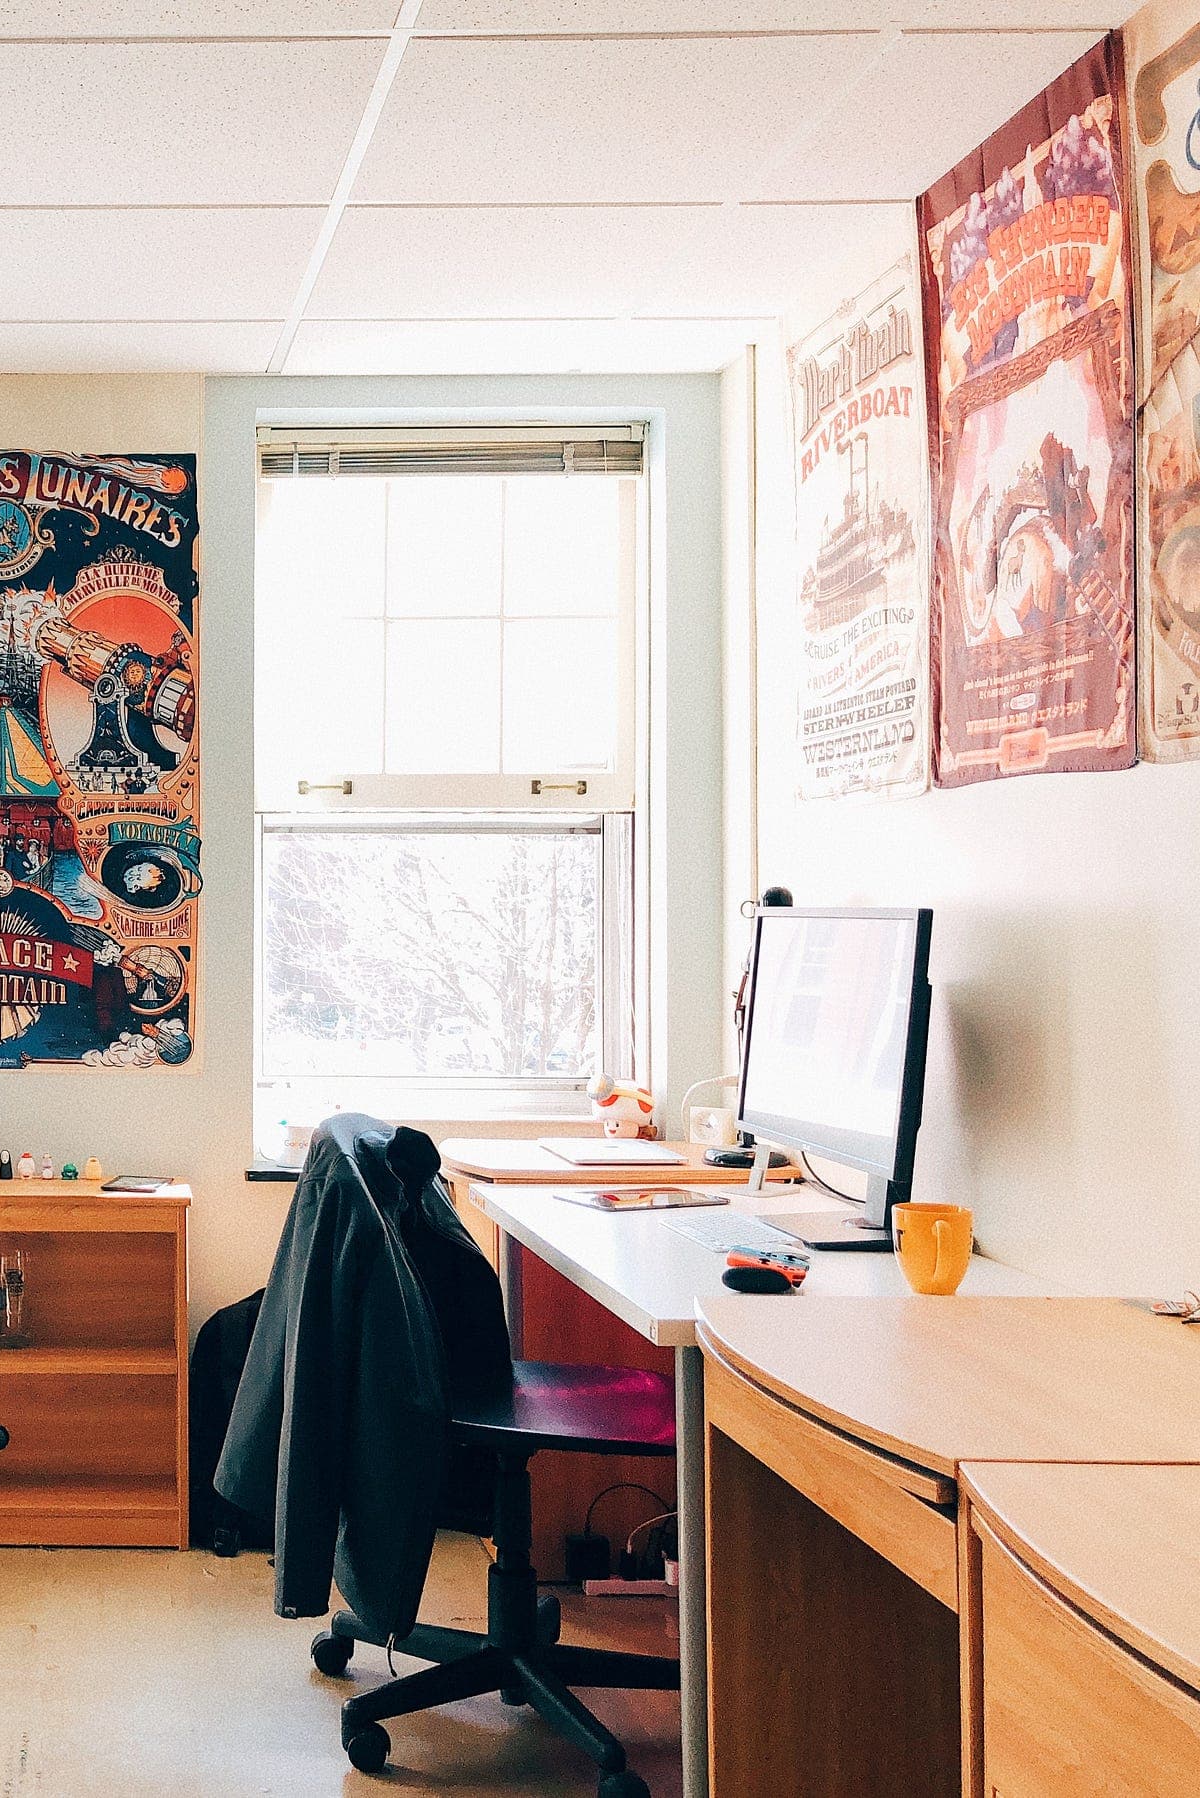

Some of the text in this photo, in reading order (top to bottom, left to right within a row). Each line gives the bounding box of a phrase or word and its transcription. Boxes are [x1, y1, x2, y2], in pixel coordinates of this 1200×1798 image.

[986, 195, 1110, 280] THUNDER
[966, 247, 1091, 366] MOUNTAIN
[799, 343, 851, 442] Mark
[846, 304, 912, 386] Twain
[801, 386, 912, 484] RIVERBOAT
[23, 453, 189, 548] LUNAIRES
[64, 576, 130, 610] MERVEILLE
[142, 578, 179, 608] MONDE
[806, 607, 915, 660] CRUISE THE EXCITING
[854, 640, 900, 683] AMERICA
[802, 718, 916, 765] WESTERNLAND
